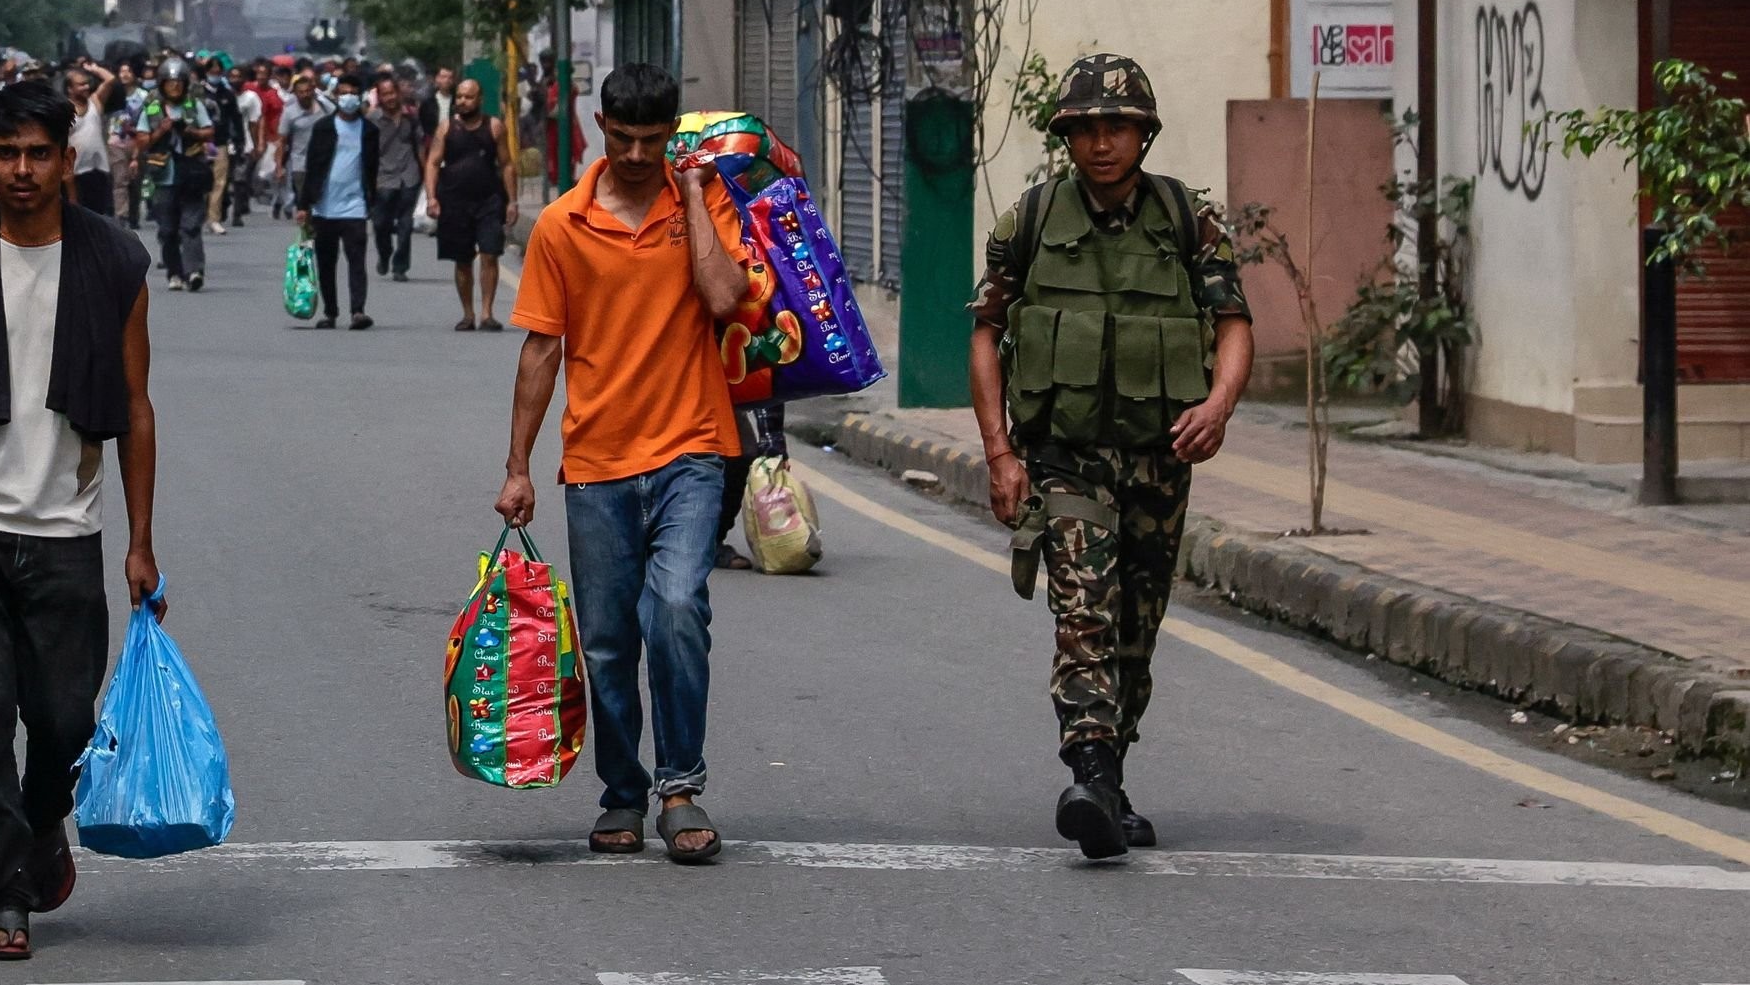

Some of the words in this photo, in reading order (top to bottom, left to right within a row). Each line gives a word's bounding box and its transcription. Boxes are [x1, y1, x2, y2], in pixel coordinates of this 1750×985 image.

[479, 614, 496, 627] Bee
[474, 648, 499, 661] Cloud
[472, 682, 494, 696] Star
